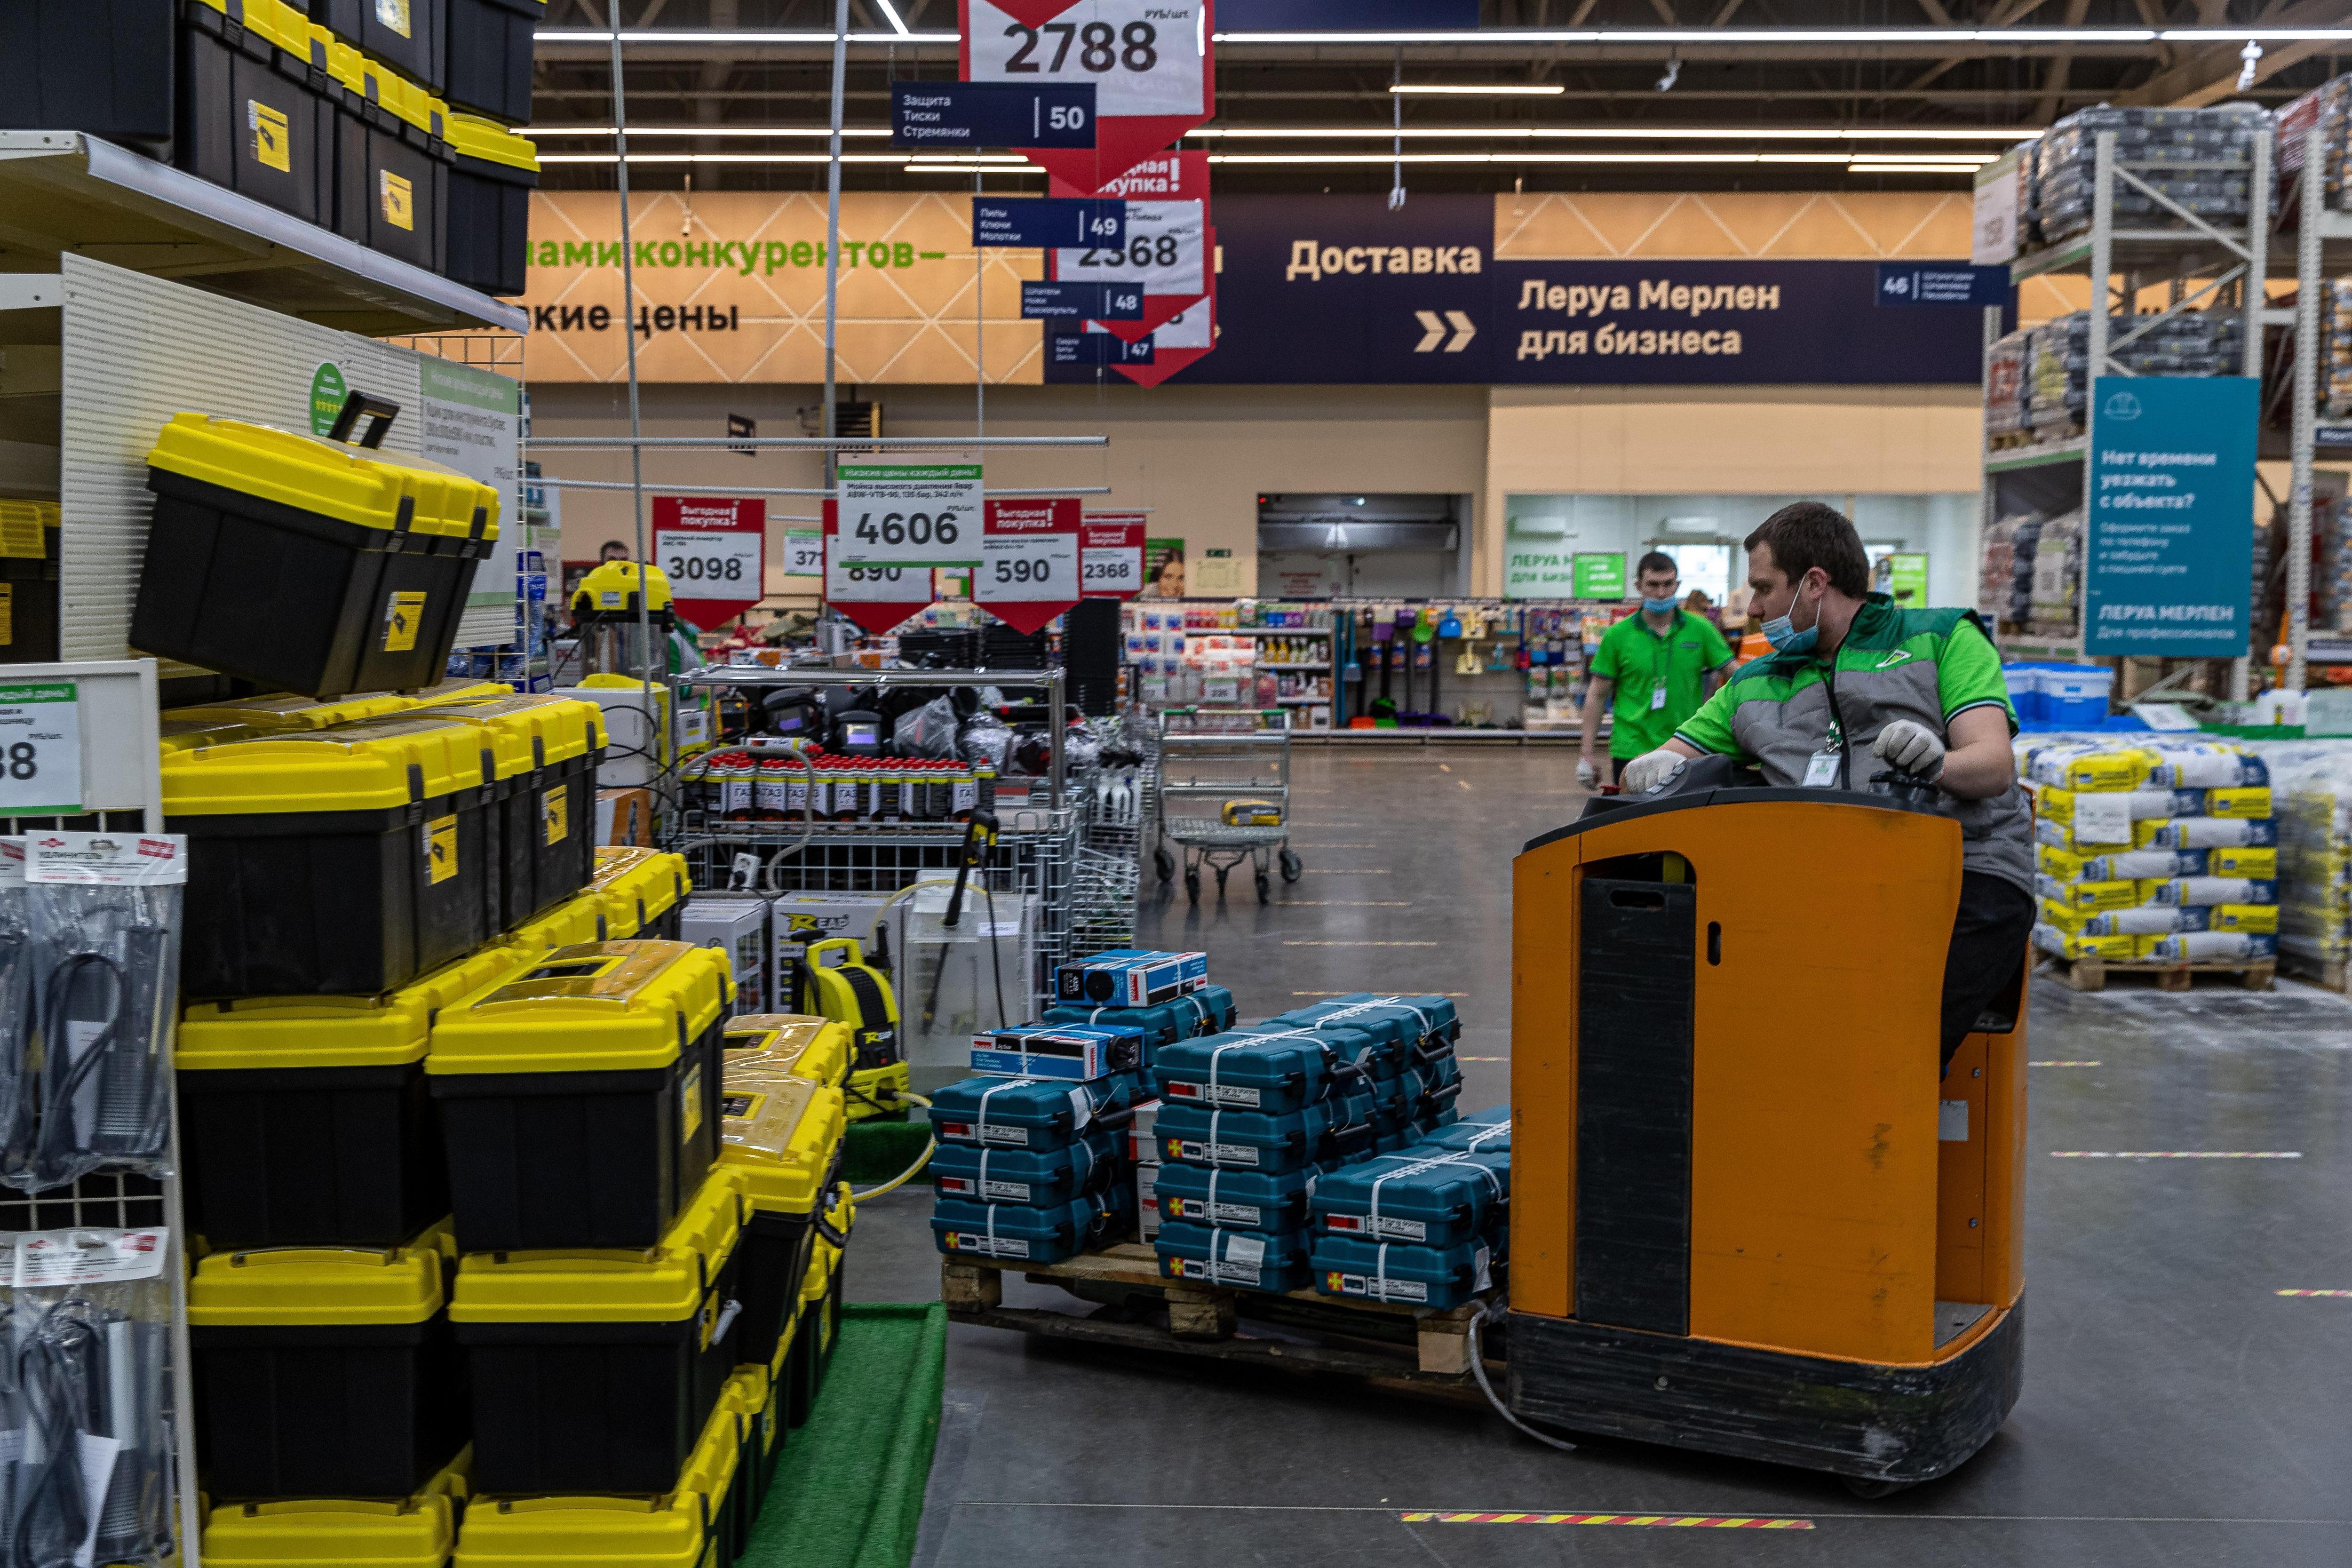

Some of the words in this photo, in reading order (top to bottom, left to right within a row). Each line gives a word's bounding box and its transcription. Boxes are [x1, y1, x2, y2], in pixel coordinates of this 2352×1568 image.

[1002, 21, 1158, 74] 2788
[903, 95, 951, 107] Защита
[903, 110, 940, 121] Тиски
[1049, 106, 1085, 129] 50
[903, 126, 970, 139] Стремянки
[980, 208, 1007, 218] Пилы
[980, 220, 1011, 230] Ключи
[1090, 217, 1118, 236] 49
[980, 232, 1021, 242] Молотки
[1078, 236, 1178, 268] 2368
[1286, 239, 1482, 281] Доставка
[1883, 276, 1909, 294] 46
[1115, 295, 1138, 310] 48
[1518, 279, 1630, 318] Леруа
[1638, 280, 1780, 317] Мерлен
[634, 303, 739, 339] цены
[1131, 343, 1150, 357] 47
[1517, 327, 1588, 360] для
[1594, 322, 1742, 355] бизнеса
[2100, 450, 2136, 465] Нет
[2138, 452, 2217, 469] времени
[909, 468, 949, 478] каждый
[949, 468, 977, 478] день!
[681, 506, 731, 516] Выгодная
[996, 509, 1047, 518] Выгодная
[855, 512, 959, 545] 4606
[668, 556, 742, 581] 3098
[995, 559, 1050, 583] 590
[1084, 564, 1130, 579] 2368
[2098, 604, 2156, 621] ЛЕРУА
[2158, 605, 2234, 622] МЕРЛЕН
